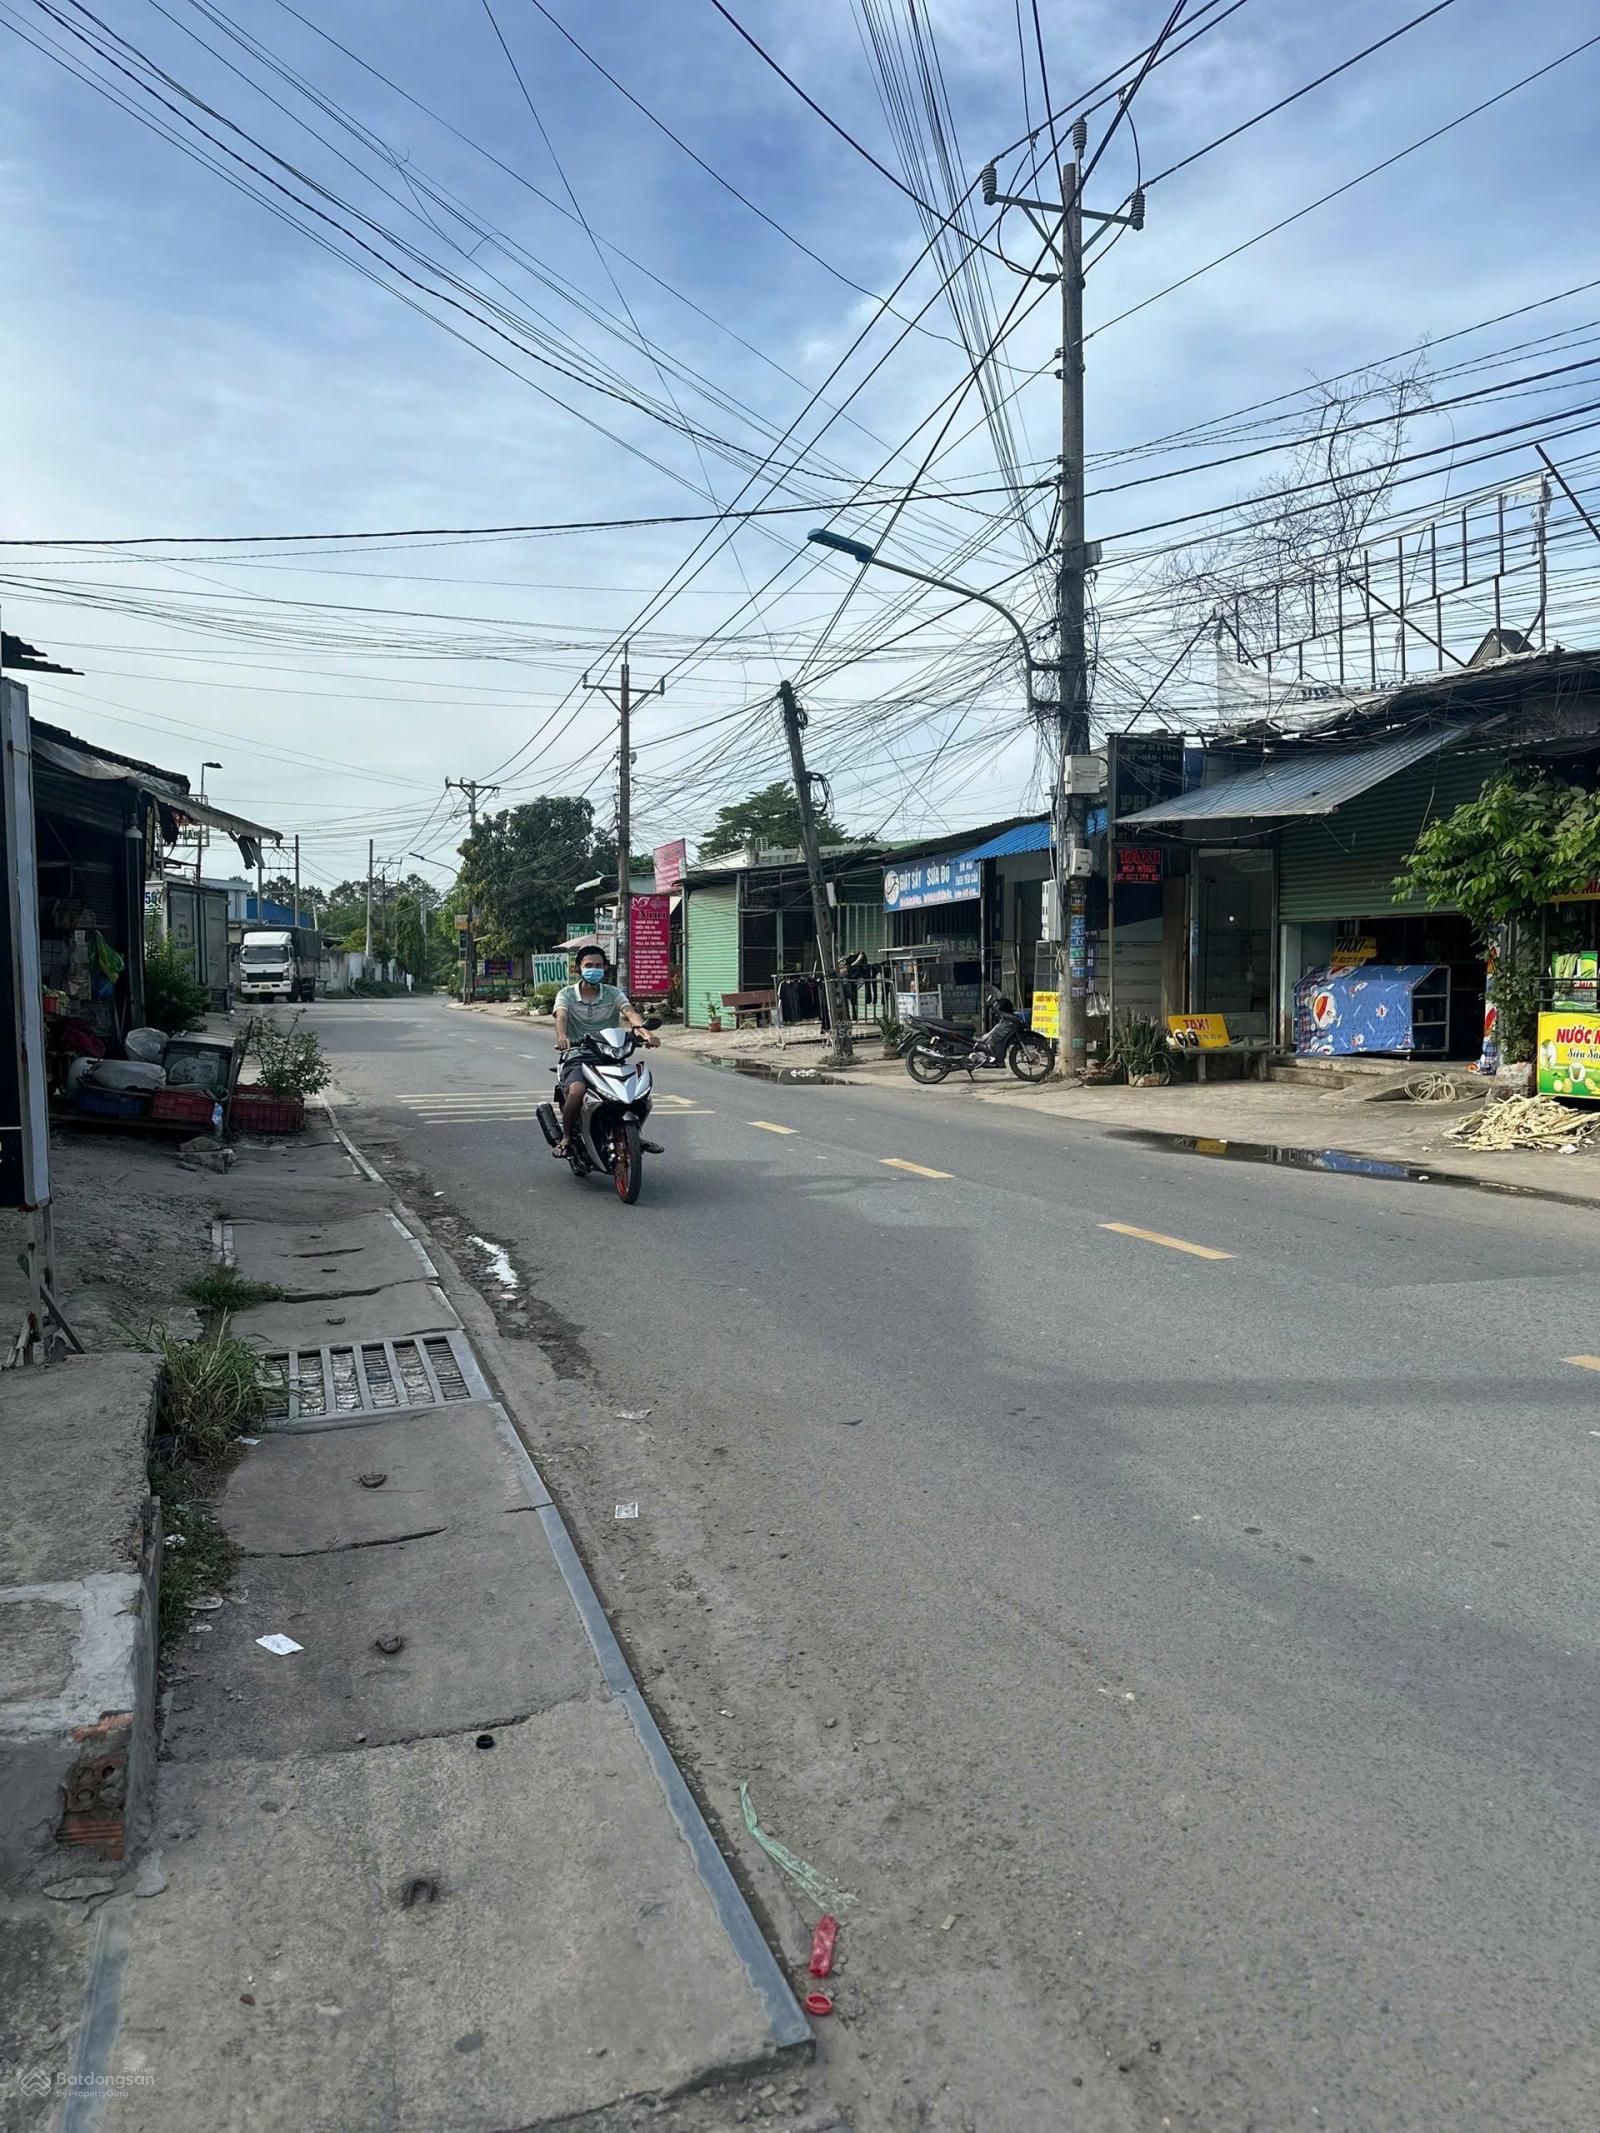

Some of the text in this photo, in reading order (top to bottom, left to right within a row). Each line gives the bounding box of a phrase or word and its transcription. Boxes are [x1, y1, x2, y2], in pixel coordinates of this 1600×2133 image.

[1119, 849, 1160, 864] TAXI
[1336, 937, 1365, 953] TAXI
[1182, 1018, 1209, 1030] TAXI
[1556, 1025, 1592, 1044] NƯỚC
